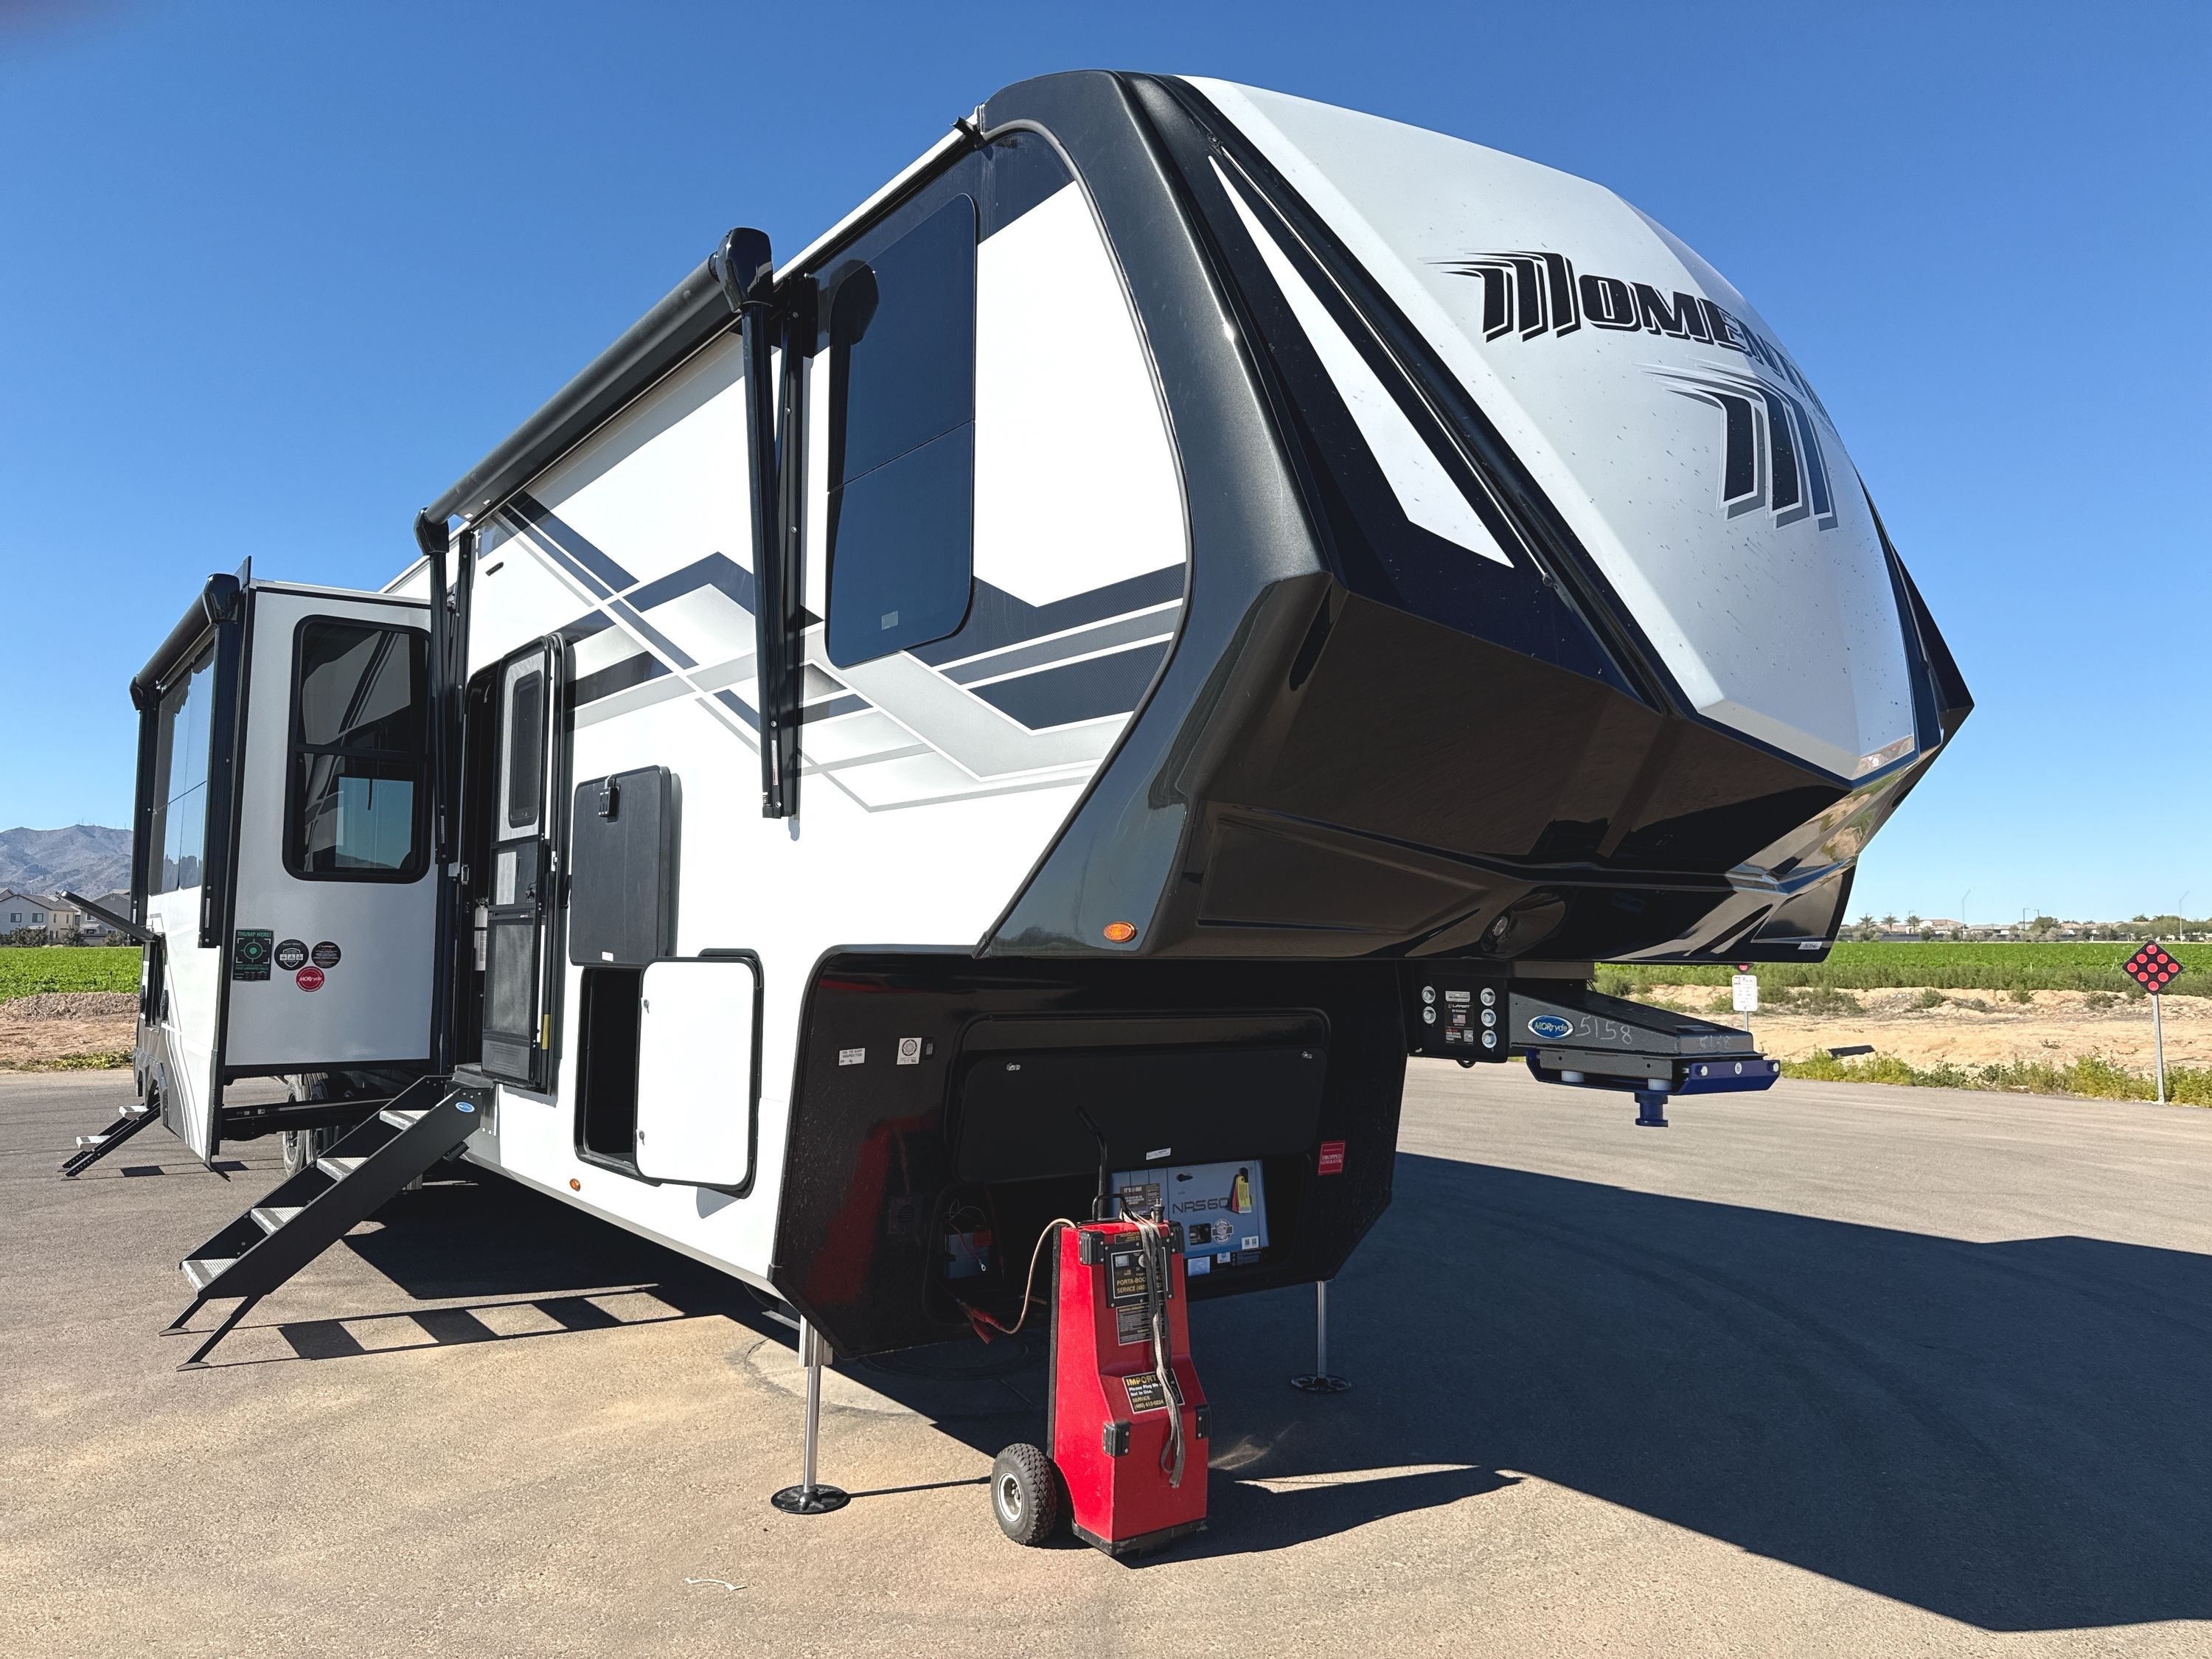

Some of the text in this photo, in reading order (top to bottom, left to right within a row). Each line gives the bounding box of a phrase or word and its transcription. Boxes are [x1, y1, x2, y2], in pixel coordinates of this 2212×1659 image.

[1534, 1022, 1568, 1032] MORryde
[1576, 1015, 1632, 1044] 5158
[1116, 1285, 1136, 1294] SERVICE
